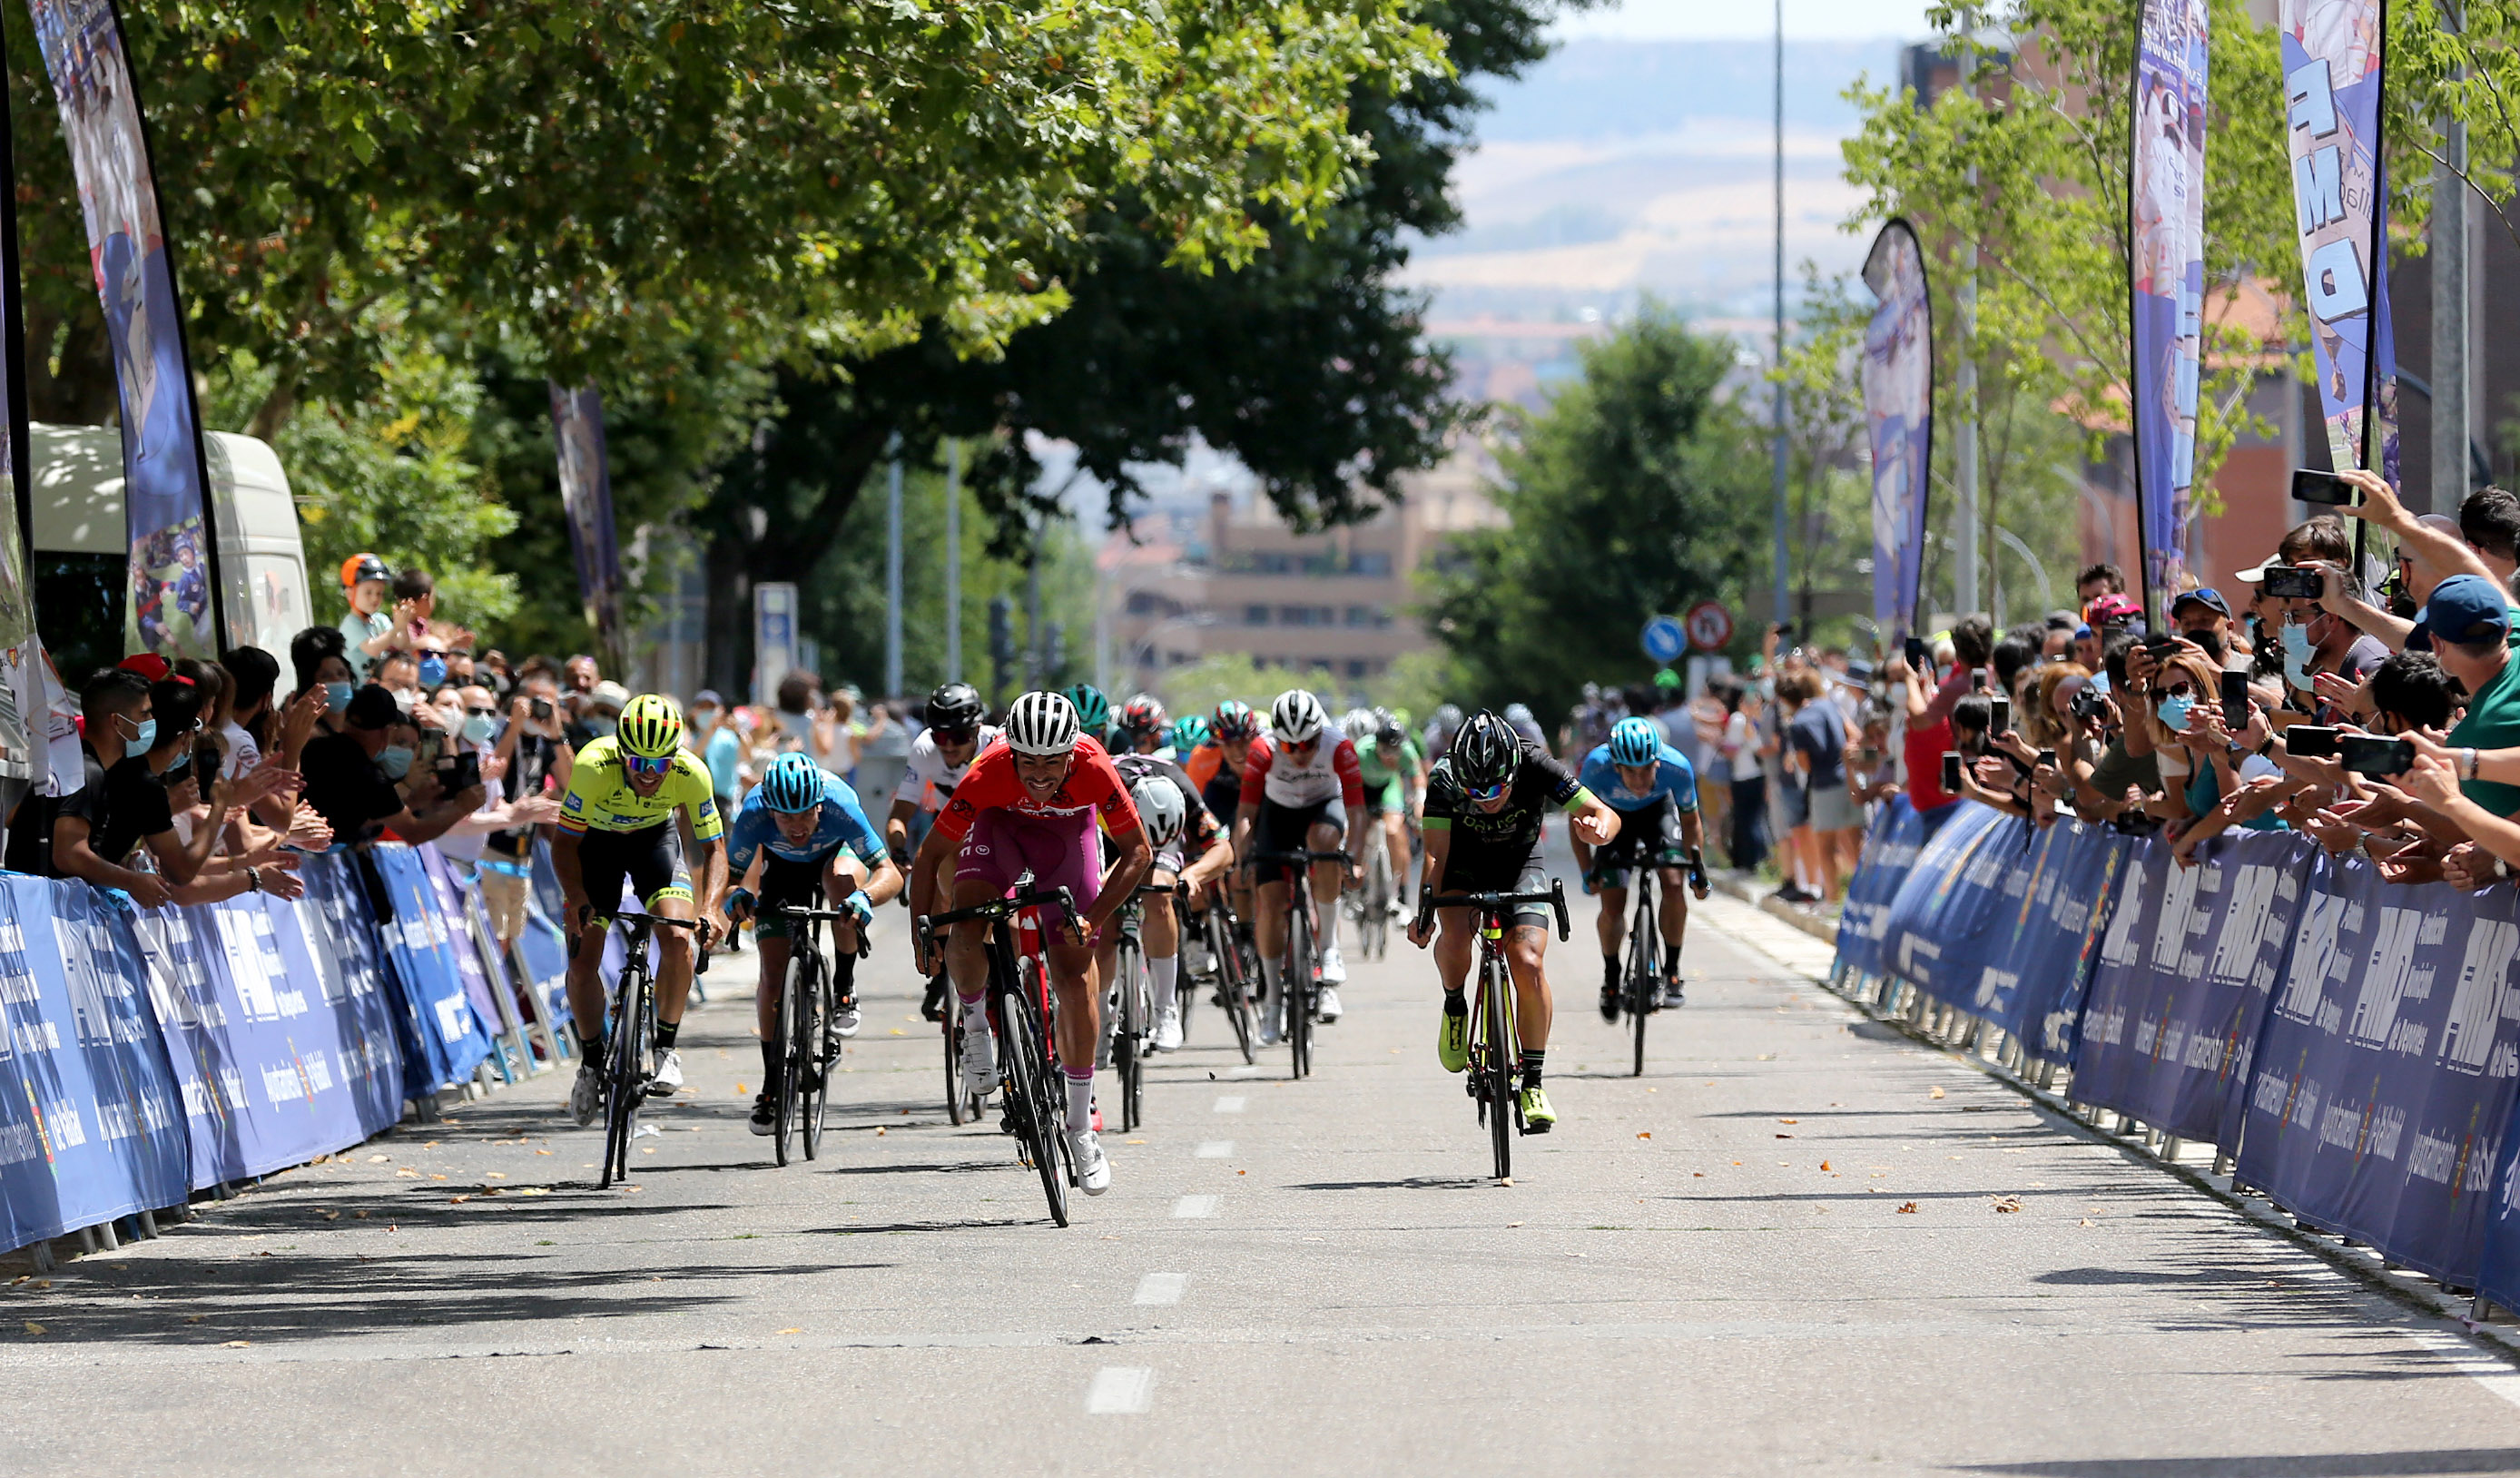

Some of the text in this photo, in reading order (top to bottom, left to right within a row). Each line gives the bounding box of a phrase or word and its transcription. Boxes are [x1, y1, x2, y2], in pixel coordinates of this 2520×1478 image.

[2207, 864, 2278, 987] FMD
[2346, 906, 2422, 1051] FMD
[2435, 916, 2520, 1077] FMD
